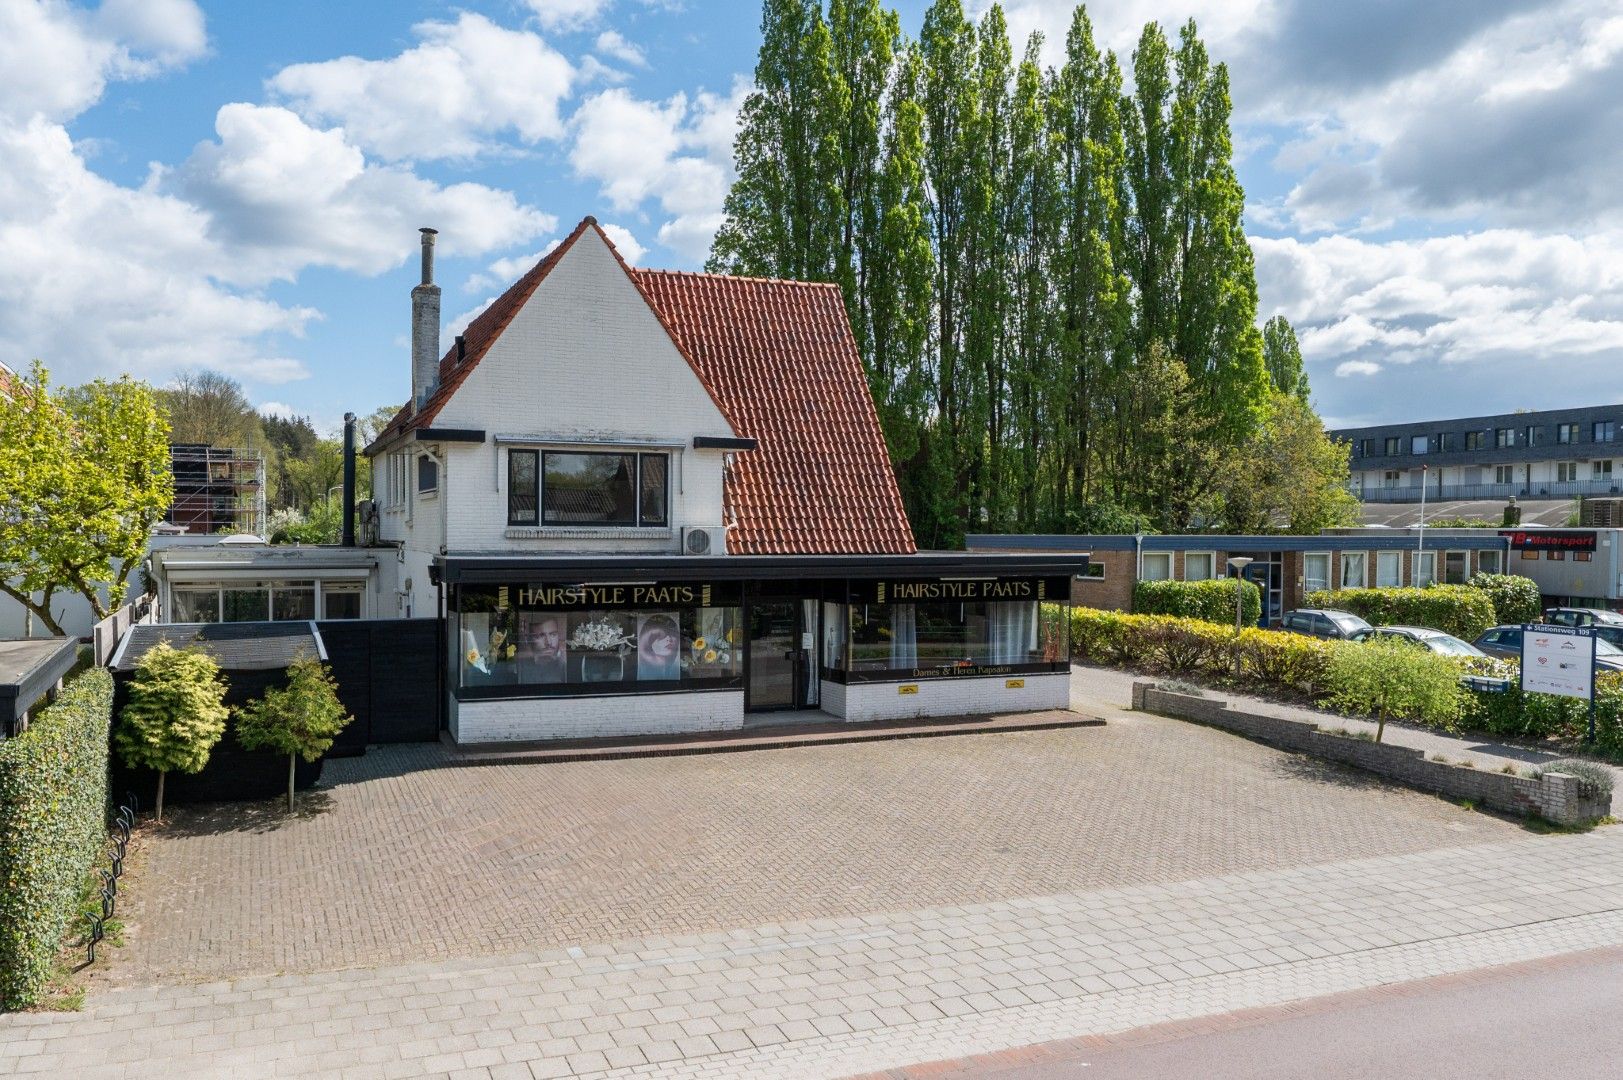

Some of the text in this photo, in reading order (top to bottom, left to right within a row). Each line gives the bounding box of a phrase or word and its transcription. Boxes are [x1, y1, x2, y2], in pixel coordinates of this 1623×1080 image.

[1531, 535, 1593, 546] Motorsport
[893, 581, 1031, 598] HAIRSTYLE PAATS
[518, 586, 694, 605] HAIRSTYLE PAATS
[1534, 625, 1576, 635] Stationsweg
[913, 666, 1012, 677] Dames & Heren Kapsalon
